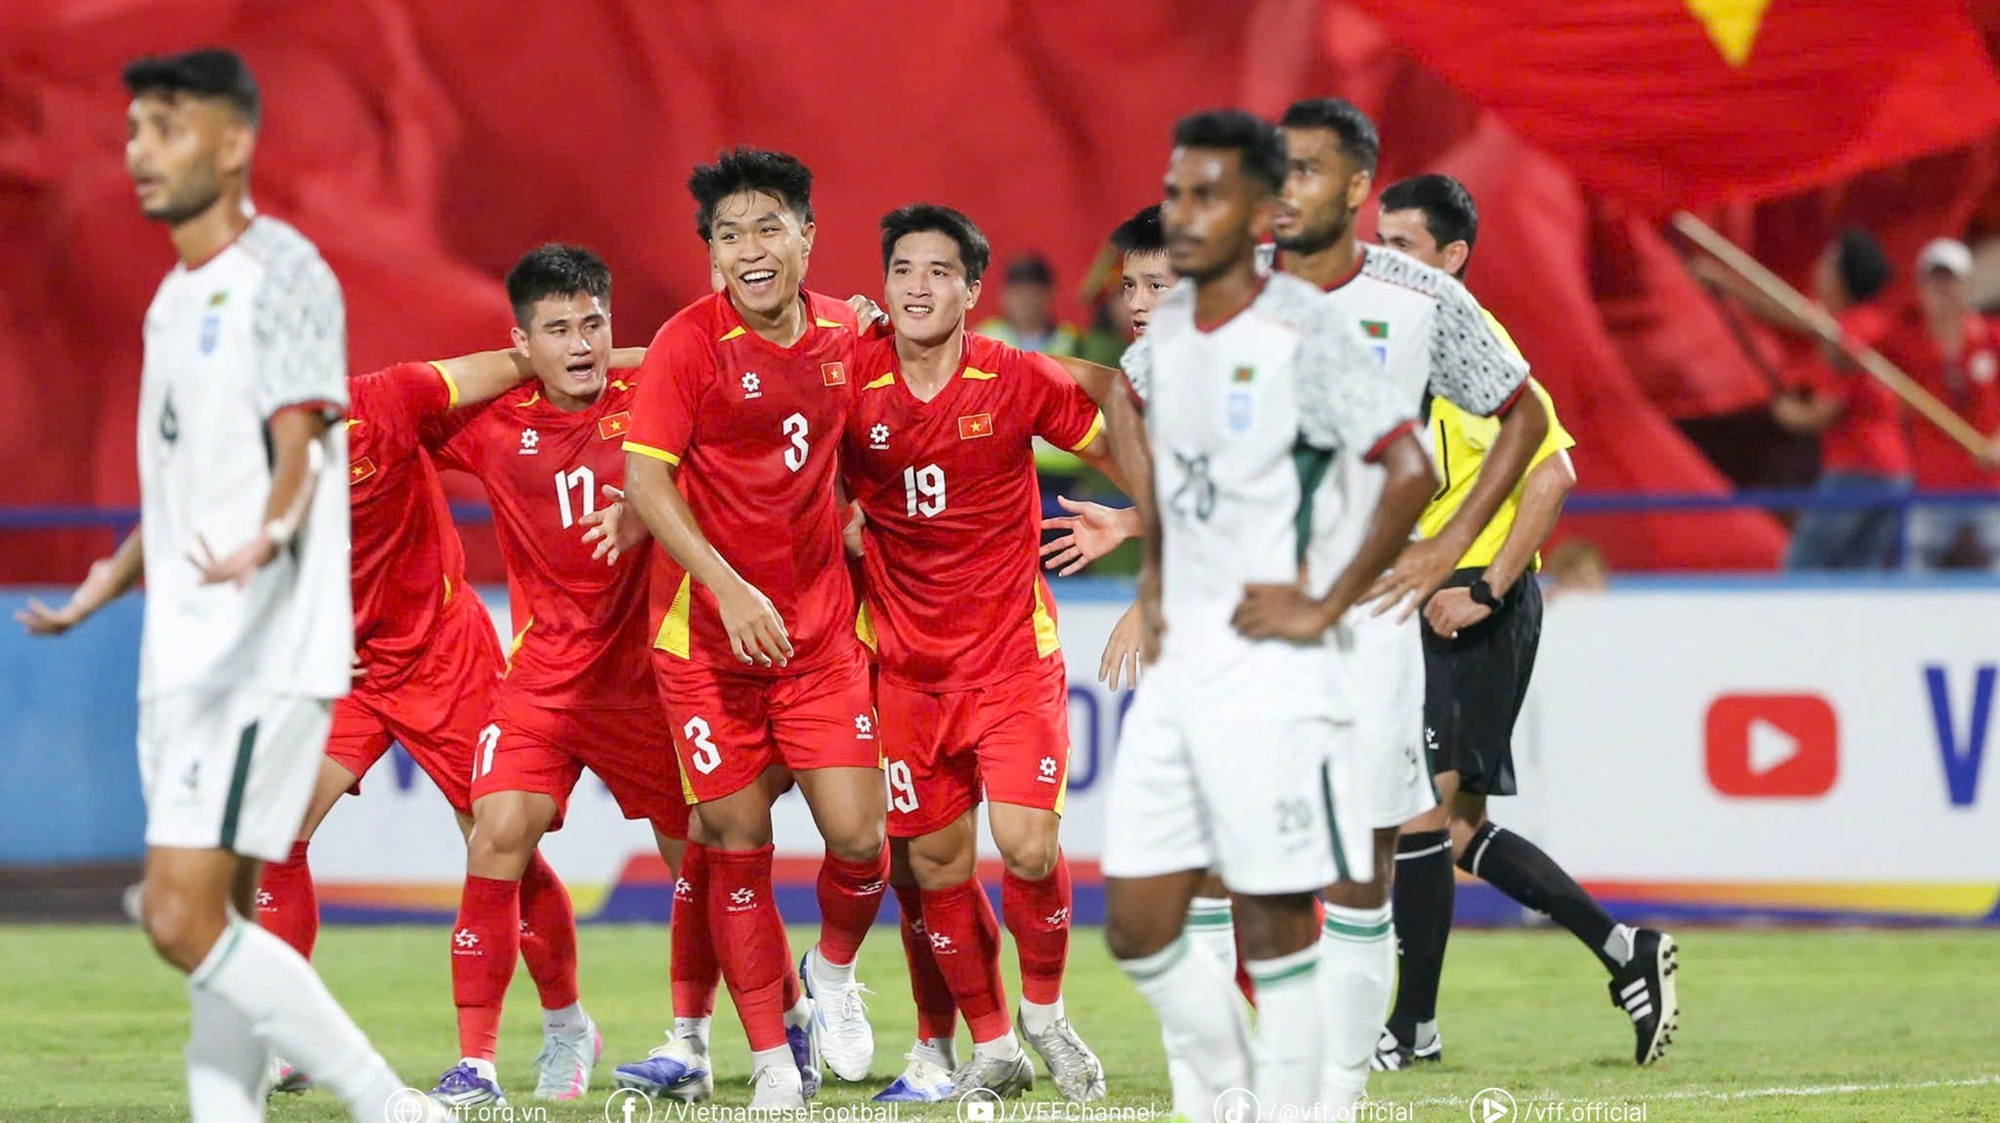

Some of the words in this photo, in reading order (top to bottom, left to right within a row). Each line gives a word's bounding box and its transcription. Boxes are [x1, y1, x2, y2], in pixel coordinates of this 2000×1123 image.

[783, 412, 809, 472] 3
[555, 465, 594, 529] 17
[904, 463, 946, 518] 19
[684, 715, 722, 775] 3
[1274, 797, 1313, 834] 20
